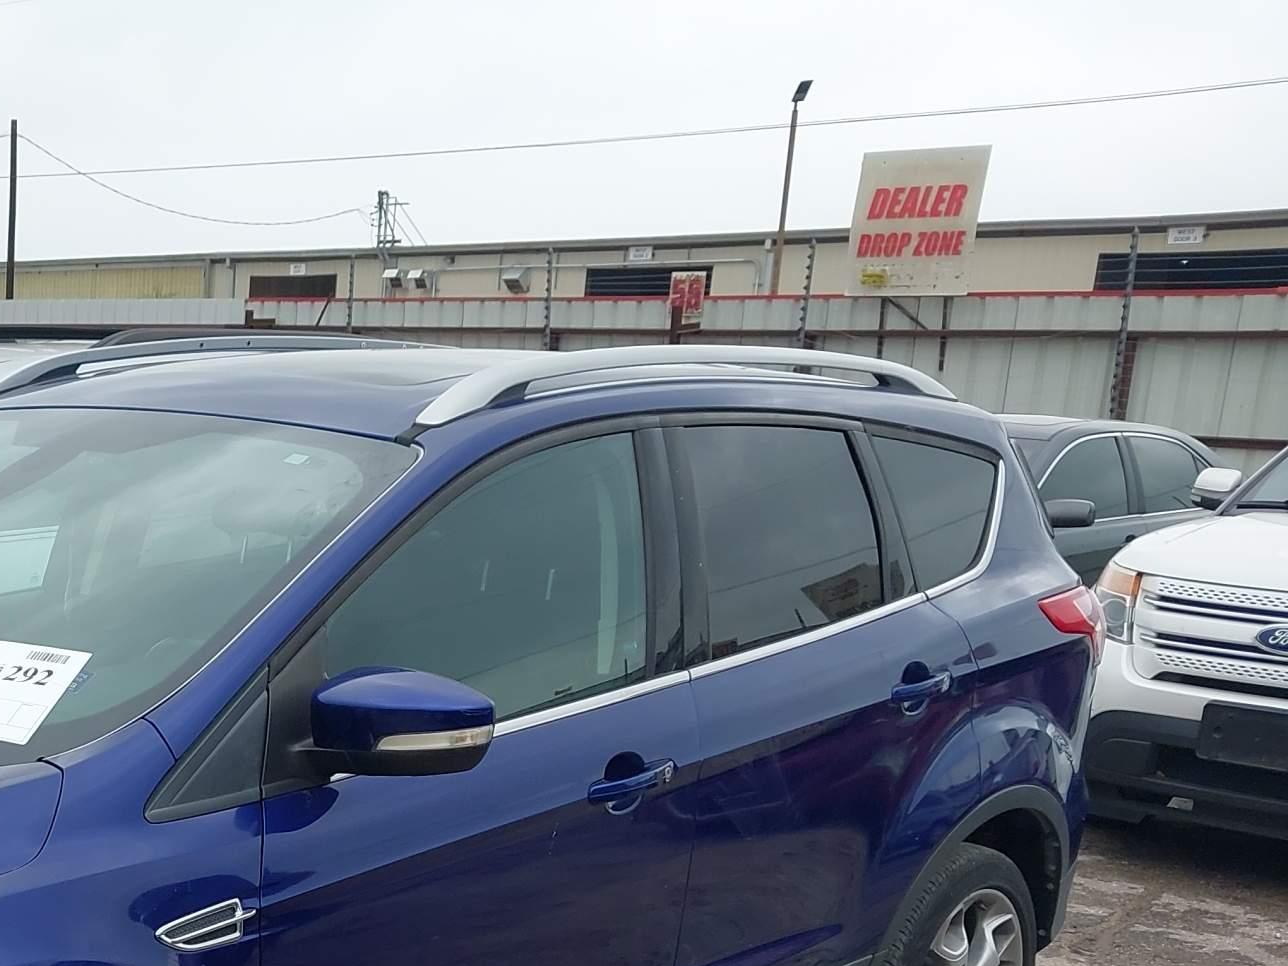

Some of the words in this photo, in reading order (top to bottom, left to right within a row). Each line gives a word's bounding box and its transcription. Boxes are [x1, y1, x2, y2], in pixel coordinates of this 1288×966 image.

[866, 183, 968, 220] DEALER
[856, 232, 912, 258] DROP
[912, 230, 967, 257] ZONE
[1268, 629, 1288, 646] Fo
